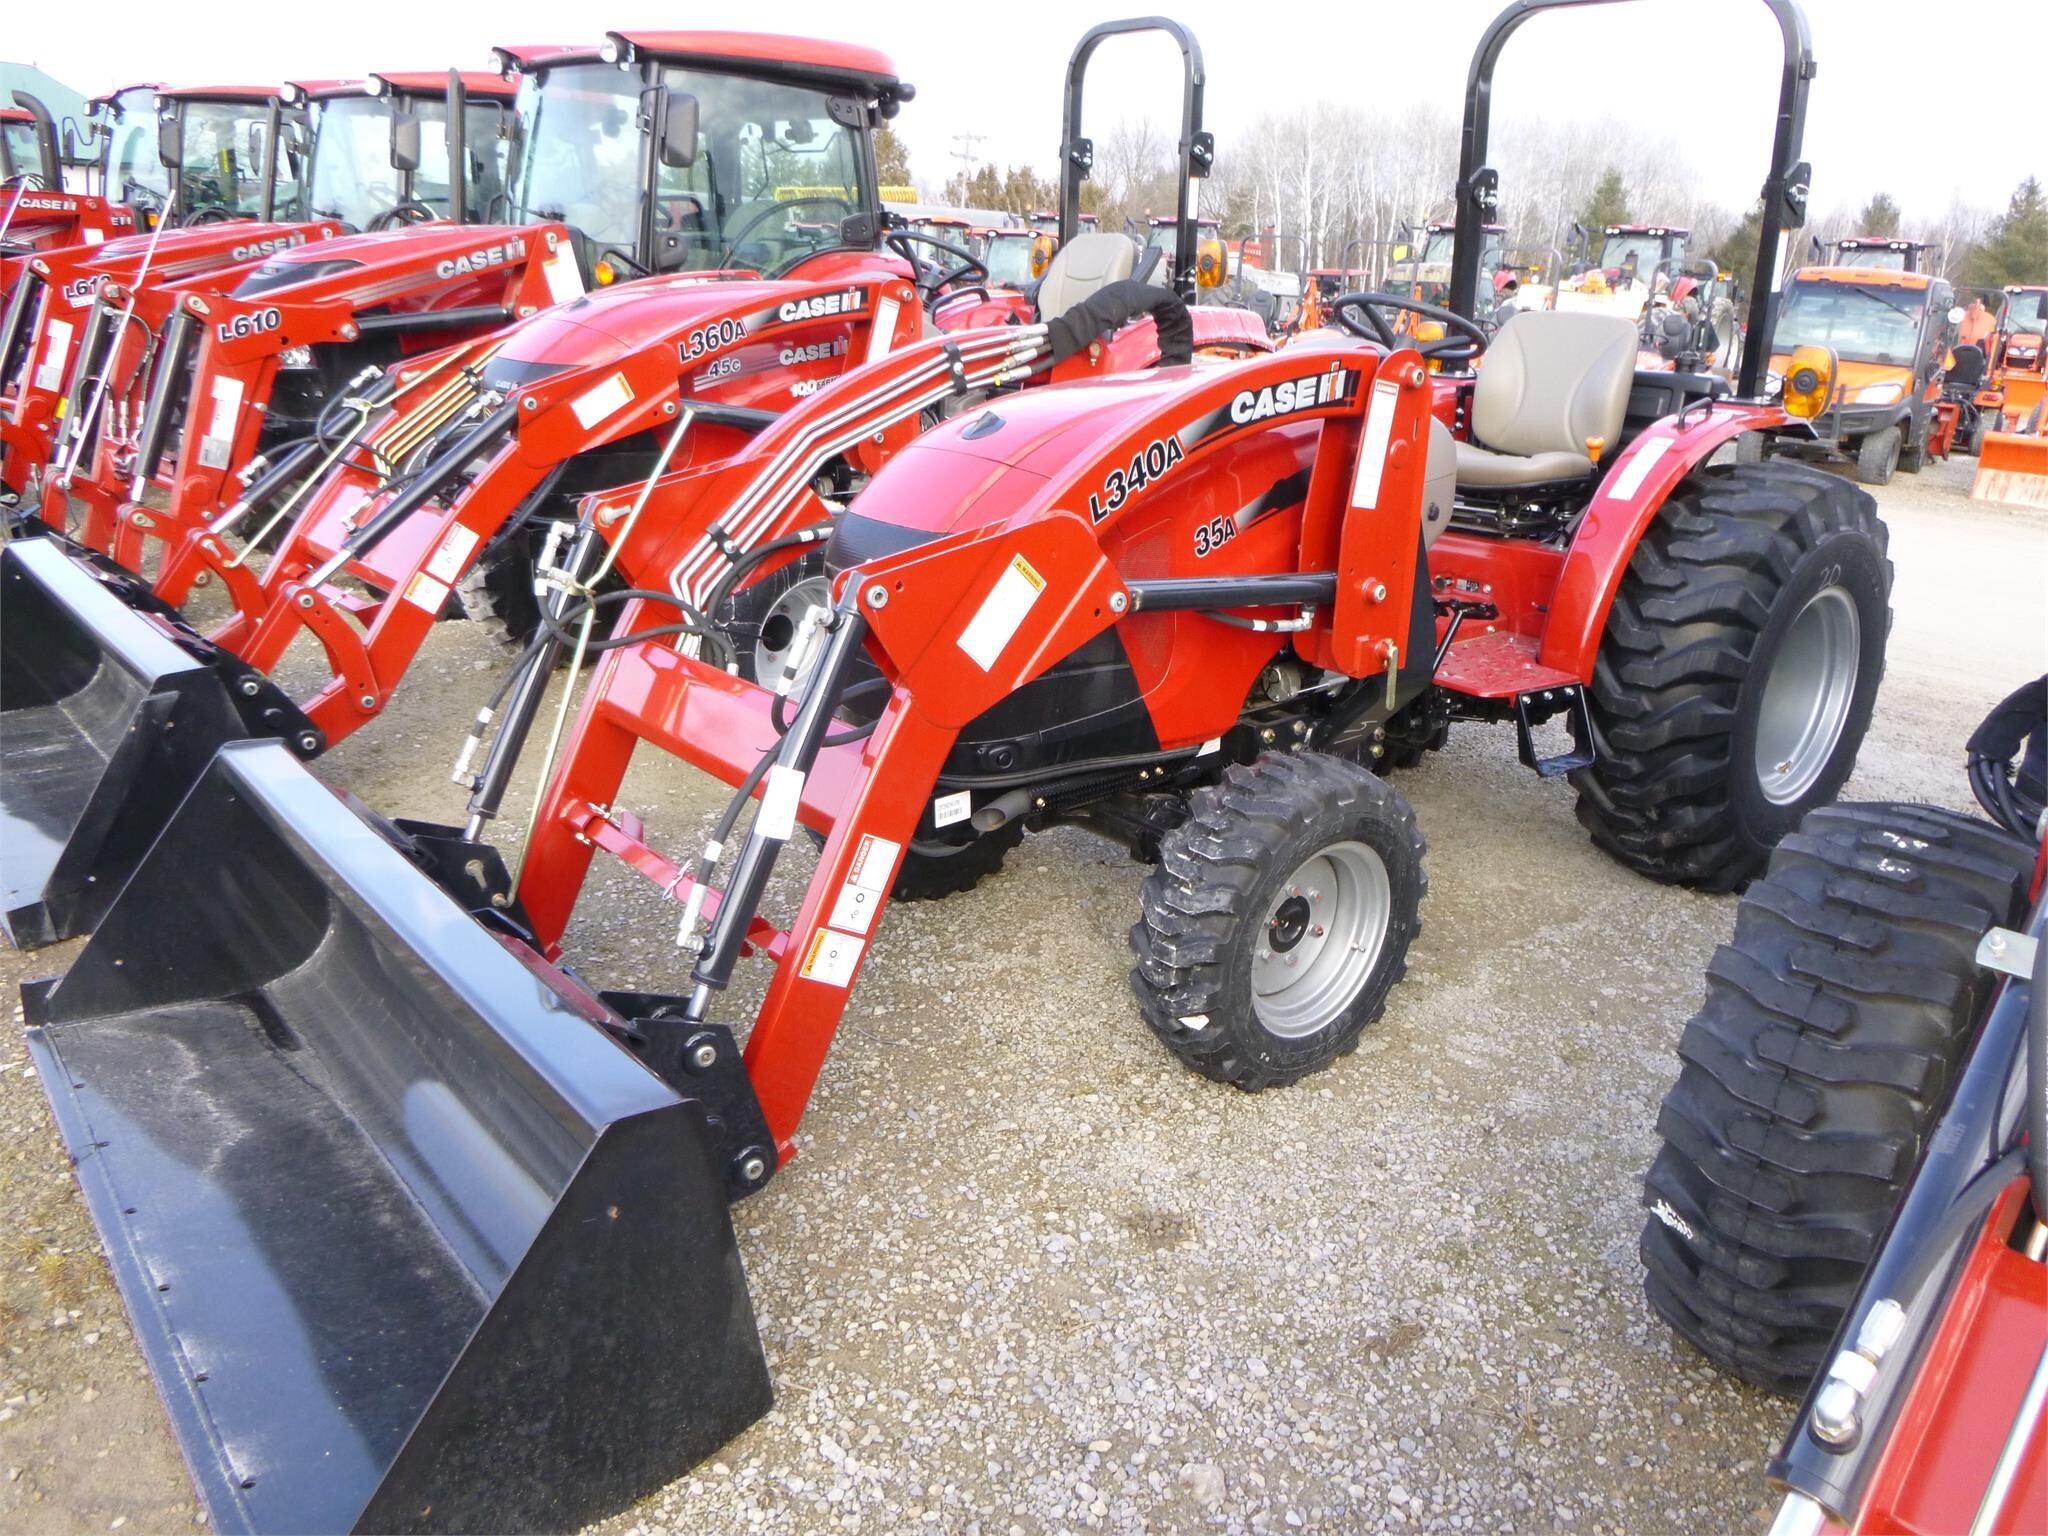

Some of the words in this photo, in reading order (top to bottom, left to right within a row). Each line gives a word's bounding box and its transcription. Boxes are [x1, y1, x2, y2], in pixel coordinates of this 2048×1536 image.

[19, 198, 62, 210] CASE
[232, 237, 287, 261] CASE
[436, 246, 503, 279] CASE
[218, 307, 281, 341] L610
[779, 294, 840, 322] CASE
[678, 318, 749, 365] L360A
[780, 343, 831, 366] CASE
[1231, 376, 1318, 424] CASE
[1089, 435, 1185, 526] L340A
[1194, 515, 1237, 558] 35A
[853, 839, 873, 873] DANGER
